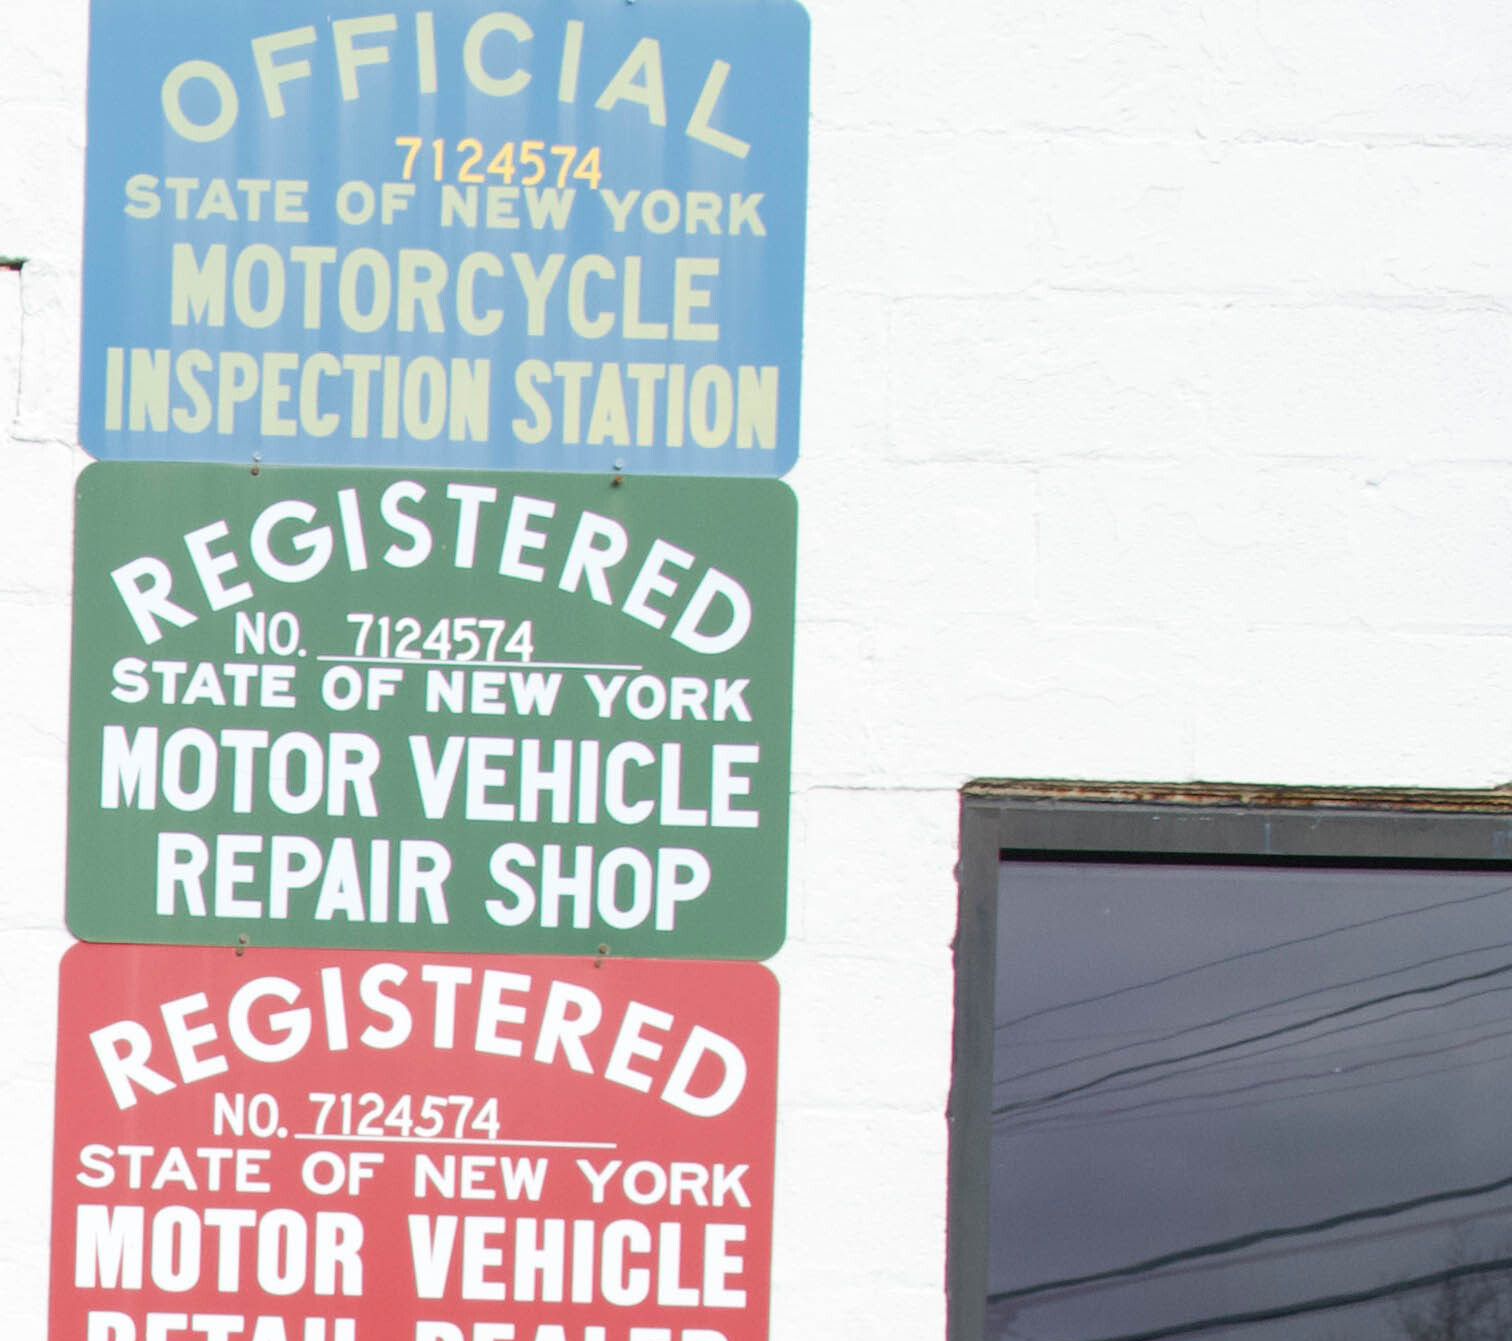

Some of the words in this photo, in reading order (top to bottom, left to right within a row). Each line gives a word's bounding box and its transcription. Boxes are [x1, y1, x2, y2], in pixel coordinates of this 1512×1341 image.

[160, 11, 751, 159] OFFICIAL
[124, 174, 309, 224] STATE
[336, 180, 416, 226] OF
[440, 184, 577, 231] NEW
[600, 188, 767, 236] YORK
[394, 136, 603, 190] 7124574
[170, 243, 720, 342] MOTORCYCLE
[105, 347, 491, 442] INSPECTION
[511, 359, 779, 450] STATION
[110, 480, 752, 655] REGISTERED
[233, 611, 307, 658] NO.
[346, 613, 534, 663] 7124574
[111, 656, 296, 709] STATE
[321, 665, 404, 711] OF
[425, 671, 563, 716] NEW
[584, 674, 753, 723] YORK
[101, 725, 381, 818] MOTOR
[409, 735, 760, 829] VEHICLE
[155, 832, 452, 924] REPAIR
[484, 841, 711, 932] SHOP
[89, 962, 748, 1118] REGISTERED
[212, 1092, 288, 1139] NO.
[307, 1092, 501, 1141] 7124574
[76, 1143, 271, 1193] STATE
[302, 1150, 385, 1197] OF
[413, 1155, 549, 1200] NEW
[576, 1159, 753, 1208] YORK
[74, 1203, 364, 1296] MOTOR
[406, 1214, 748, 1309] VEHICLE
